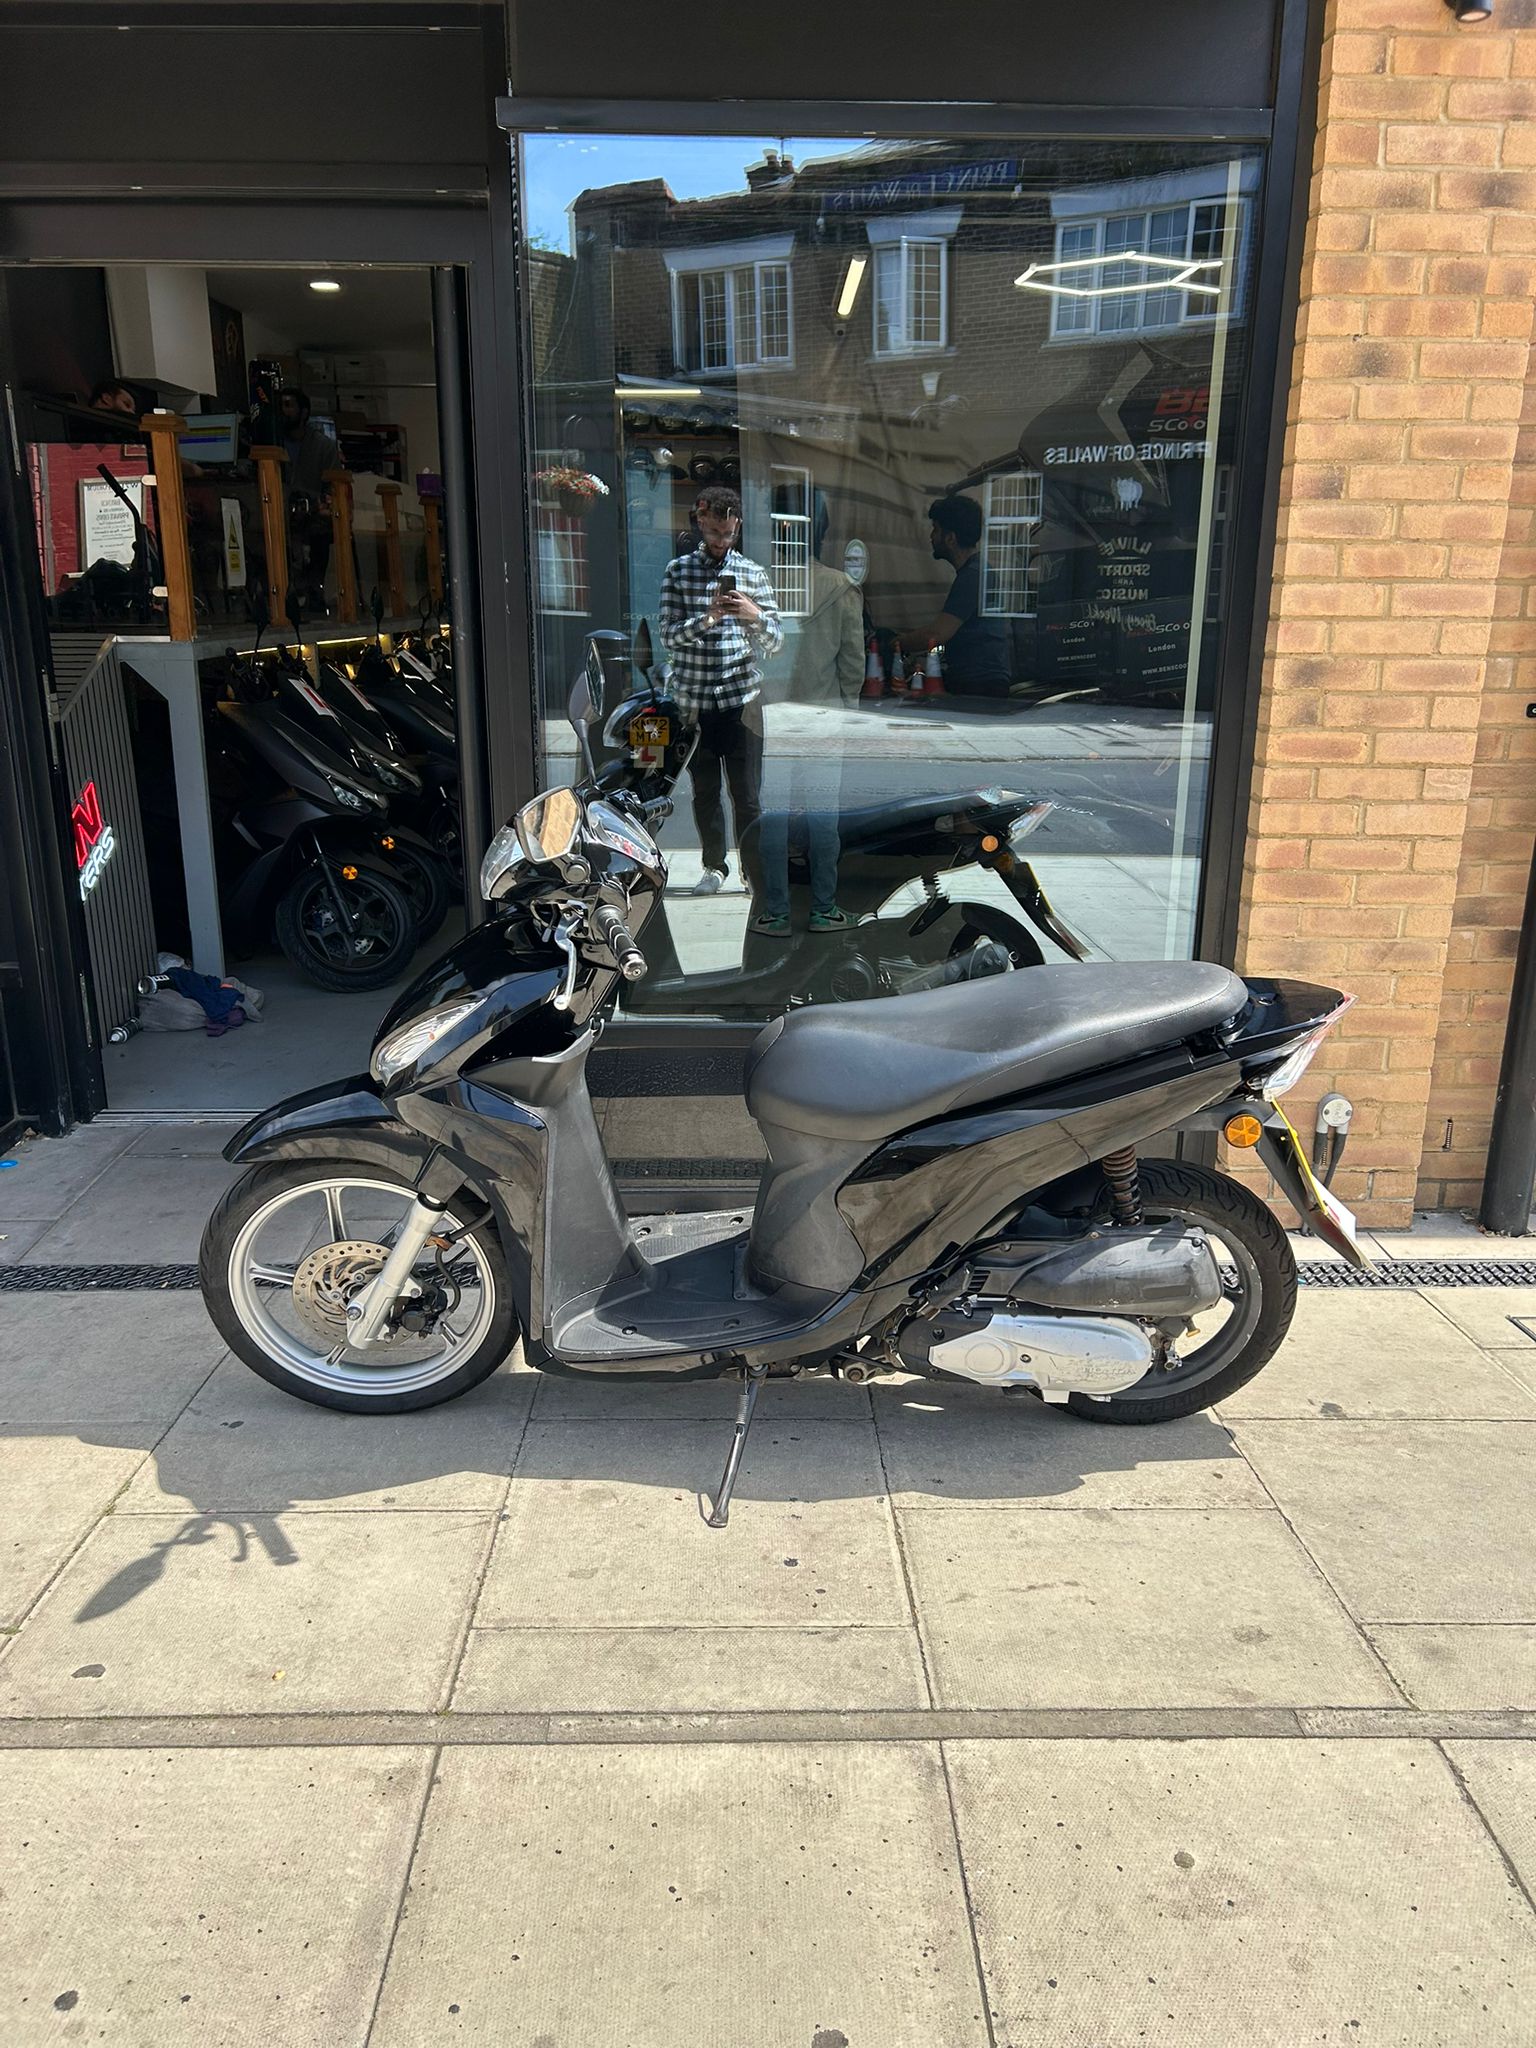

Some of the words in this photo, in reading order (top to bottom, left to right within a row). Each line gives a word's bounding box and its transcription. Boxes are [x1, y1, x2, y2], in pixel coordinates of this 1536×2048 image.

[1062, 636, 1086, 644] London
[1148, 643, 1176, 653] London
[1142, 662, 1188, 675] WWW.BENSCOO
